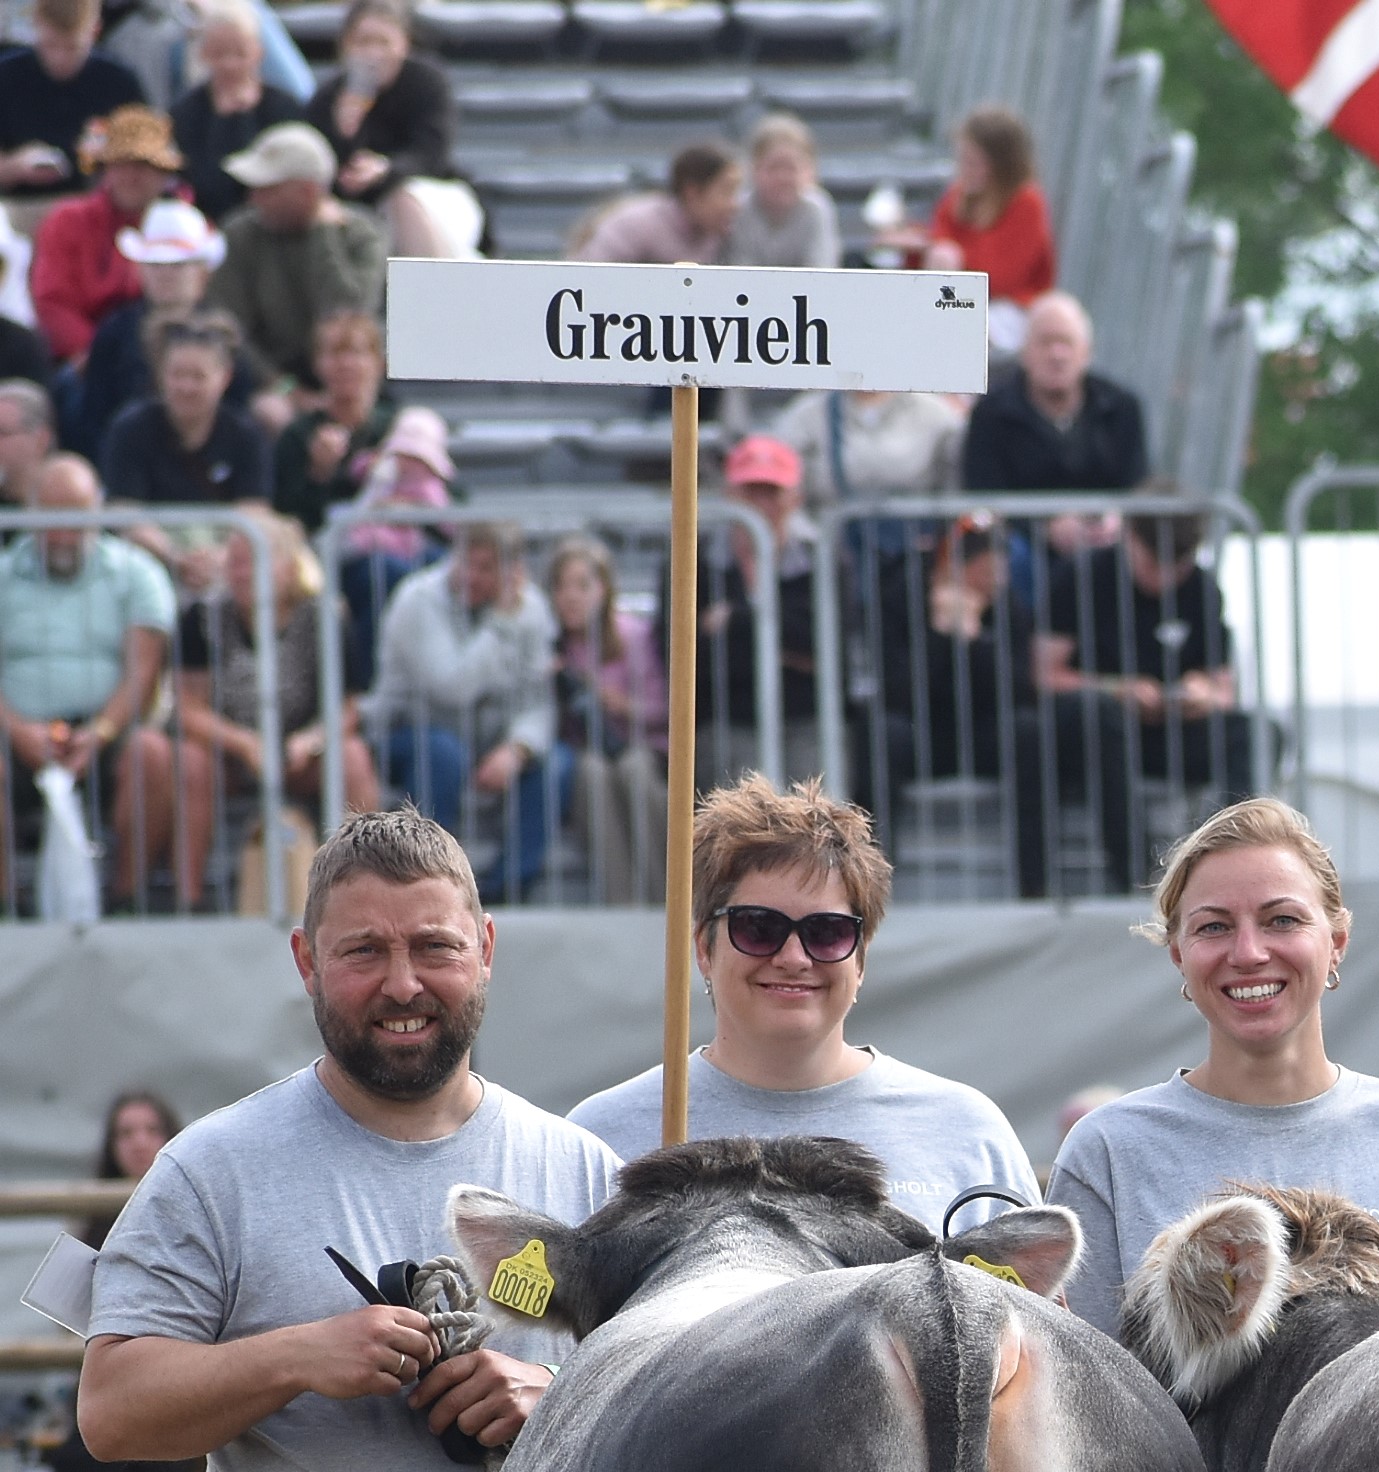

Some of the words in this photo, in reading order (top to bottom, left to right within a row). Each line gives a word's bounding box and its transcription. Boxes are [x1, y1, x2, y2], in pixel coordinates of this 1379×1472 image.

[935, 299, 975, 310] dyrskue
[545, 288, 832, 366] Grauvieh
[505, 1262, 519, 1272] DK
[492, 1269, 548, 1315] 00018
